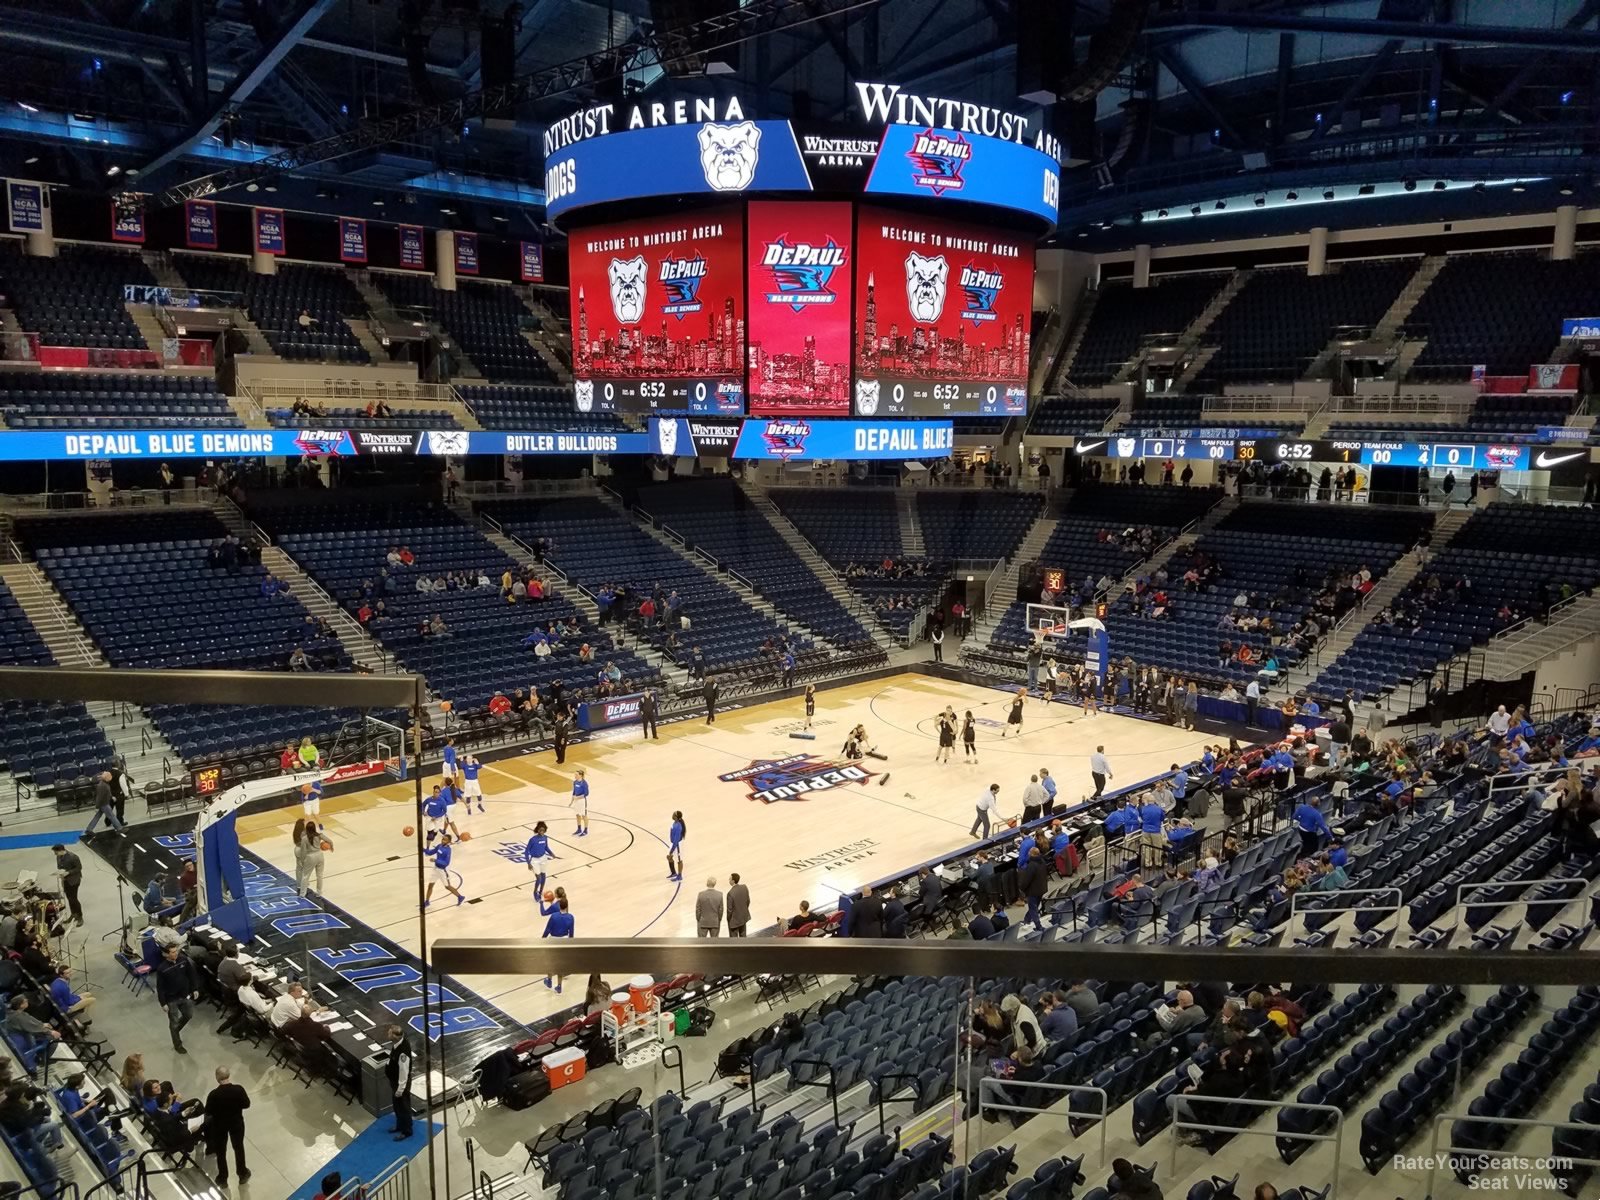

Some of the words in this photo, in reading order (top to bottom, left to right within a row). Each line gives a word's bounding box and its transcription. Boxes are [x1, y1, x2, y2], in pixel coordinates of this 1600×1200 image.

[543, 104, 614, 158] NTRUST
[628, 96, 745, 130] ARENA
[855, 81, 1028, 145] WINTRUST
[1035, 129, 1062, 164] ARE
[803, 136, 878, 152] WINTRUST
[818, 155, 863, 166] ARENA
[14, 200, 38, 208] NCAA
[191, 217, 212, 225] NCAA
[260, 224, 280, 233] NCAA
[344, 233, 362, 241] NCAA
[587, 238, 625, 253] WELCOME
[629, 236, 639, 248] TO
[643, 229, 687, 246] WINTRUST
[692, 224, 723, 239] ARENA
[882, 226, 926, 244] WELCOME
[931, 234, 942, 246] TO
[946, 236, 988, 253] WINTRUST
[992, 243, 1019, 258] ARENA
[403, 240, 420, 248] NCAA
[771, 294, 793, 302] BLUE
[796, 294, 833, 303] DEMONS
[604, 383, 615, 401] 0
[640, 382, 666, 397] 6:52
[695, 382, 707, 401] 0
[892, 384, 904, 403] 0
[933, 384, 960, 400] 6:52
[986, 386, 997, 404] 0
[692, 423, 739, 436] WINTRUST
[66, 434, 142, 455] DEPAUL
[149, 434, 195, 453] BLUE
[203, 433, 273, 452] DEMONS
[360, 432, 412, 444] WINTRUST
[506, 435, 554, 451] BUTLER
[558, 435, 617, 451] BULLDOGS
[700, 437, 729, 446] ARENA
[855, 428, 918, 451] DEPAUL
[923, 428, 946, 449] BLUE
[1153, 442, 1162, 455] 0
[1278, 444, 1313, 458] 6:52
[1333, 441, 1361, 449] PERIOD
[1176, 447, 1185, 457] 4
[1210, 447, 1224, 458] 00
[1239, 447, 1254, 459] 30
[1343, 450, 1349, 462] 1
[1373, 450, 1391, 463] 00
[1418, 451, 1428, 464] 4
[1448, 450, 1459, 463] 0
[1049, 579, 1060, 590] 30
[520, 738, 582, 754] CURT
[775, 754, 805, 769] BLUE
[199, 769, 219, 780] 6:52
[724, 762, 773, 780] DEMONS
[201, 779, 215, 792] 30
[784, 837, 876, 872] WINTRUST
[825, 850, 878, 871] ARENA
[307, 941, 504, 1043] BLUE
[563, 1064, 574, 1076] G
